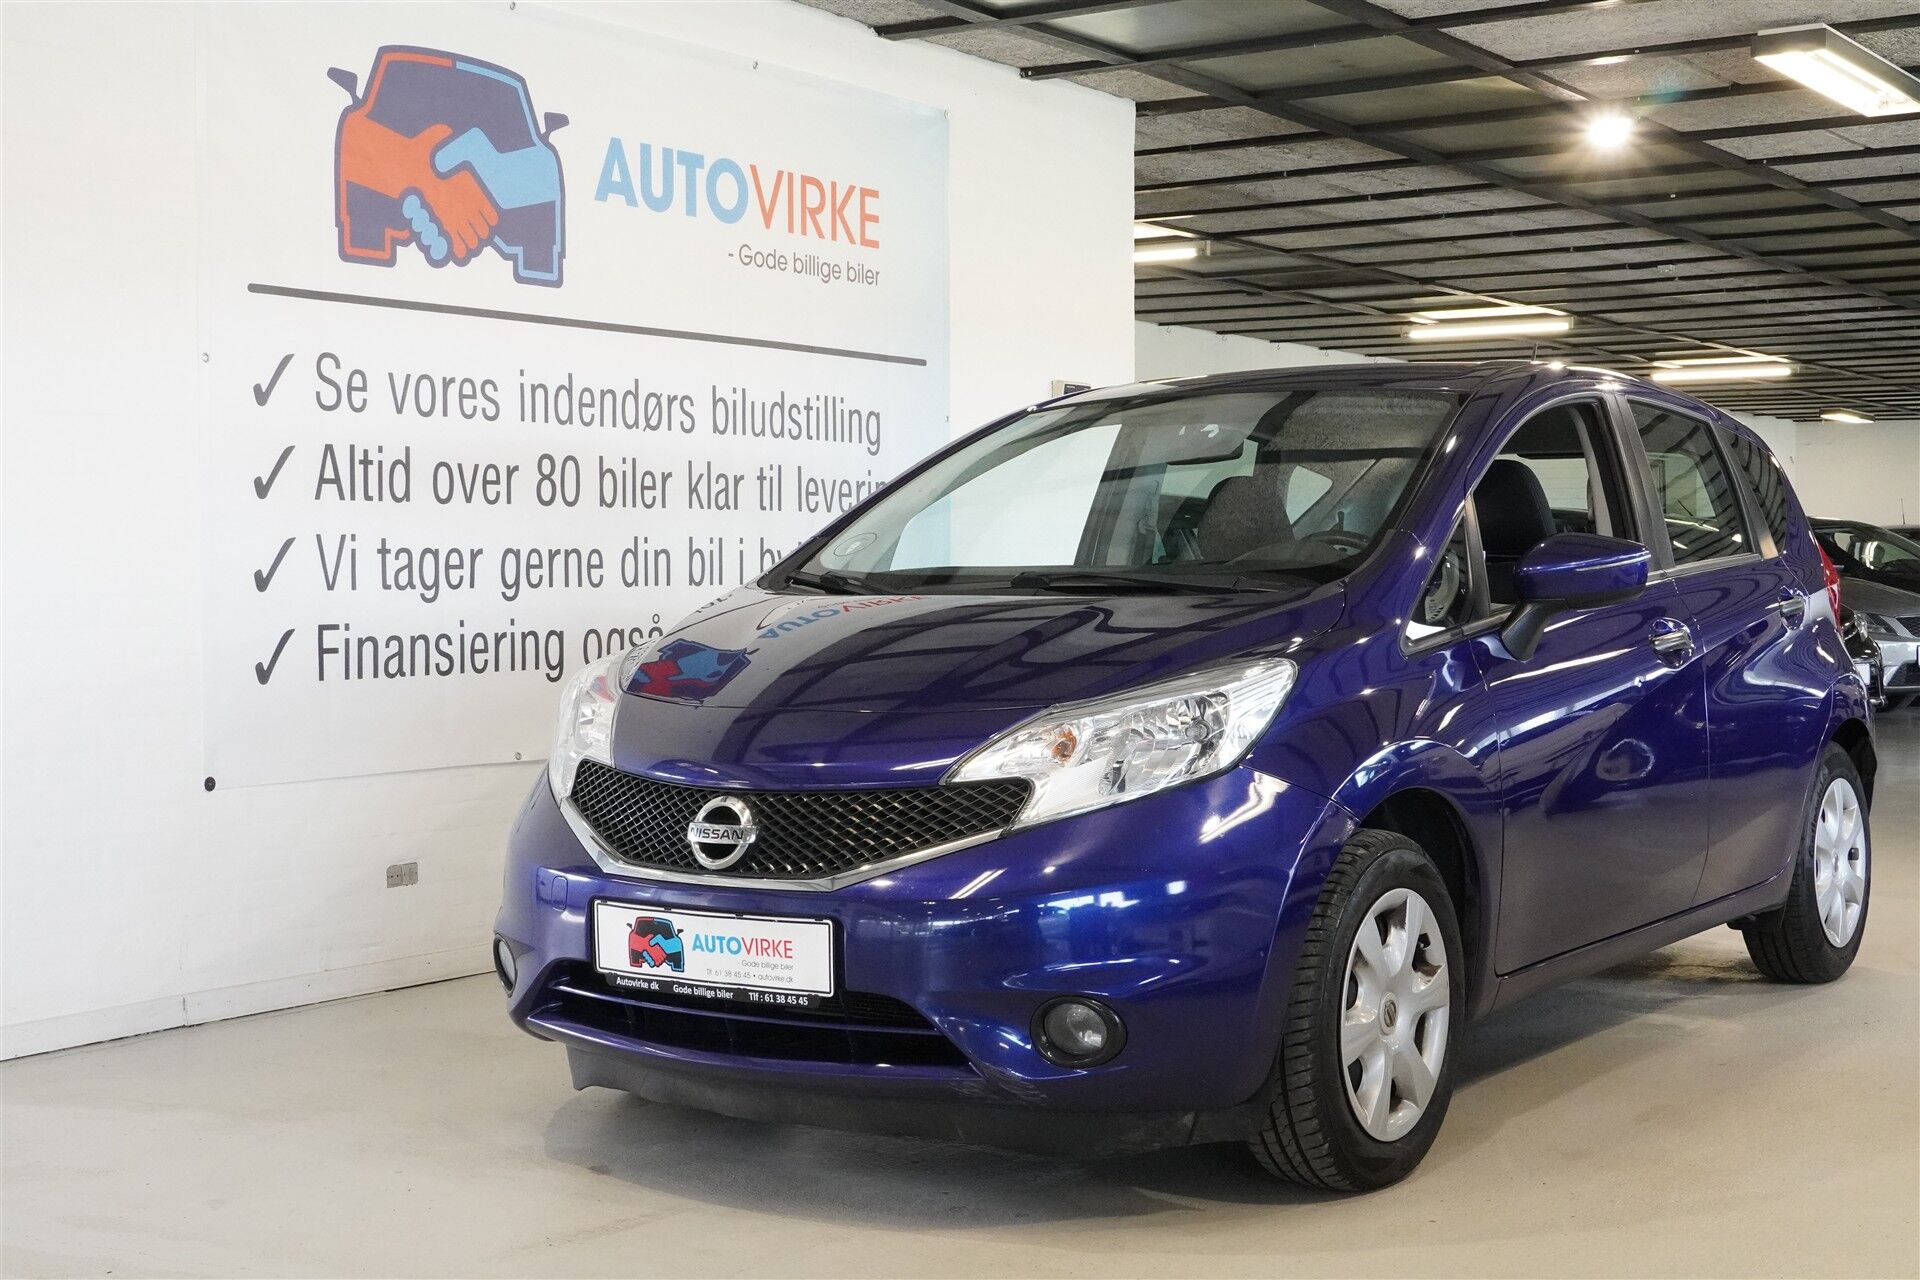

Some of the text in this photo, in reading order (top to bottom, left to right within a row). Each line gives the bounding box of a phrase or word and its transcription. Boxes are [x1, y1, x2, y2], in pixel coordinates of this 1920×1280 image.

[596, 138, 880, 249] AUTOVIRKE
[738, 244, 788, 273] Gode
[793, 253, 842, 285] billige
[846, 262, 880, 287] biler
[315, 352, 881, 456] Se vores indendørs biludstilling
[314, 444, 411, 504] Altid
[432, 461, 520, 507] over
[535, 454, 581, 508] 80
[599, 456, 673, 510] biler
[687, 460, 745, 512] klar
[757, 463, 782, 512] til
[315, 534, 357, 591] Vi
[376, 538, 484, 604] tager
[500, 547, 604, 604] gerne
[620, 536, 671, 590] din
[688, 537, 723, 588] bil
[739, 538, 745, 586] i
[316, 618, 565, 684] Finansiering
[690, 827, 744, 840] NISSAN
[692, 933, 793, 959] AUTOVIRKE
[673, 984, 692, 994] Gode
[693, 986, 715, 999] billige
[716, 988, 734, 999] biler
[764, 993, 775, 1003] 61
[775, 995, 786, 1004] 38
[787, 996, 797, 1005] 45
[798, 997, 809, 1006] 45
